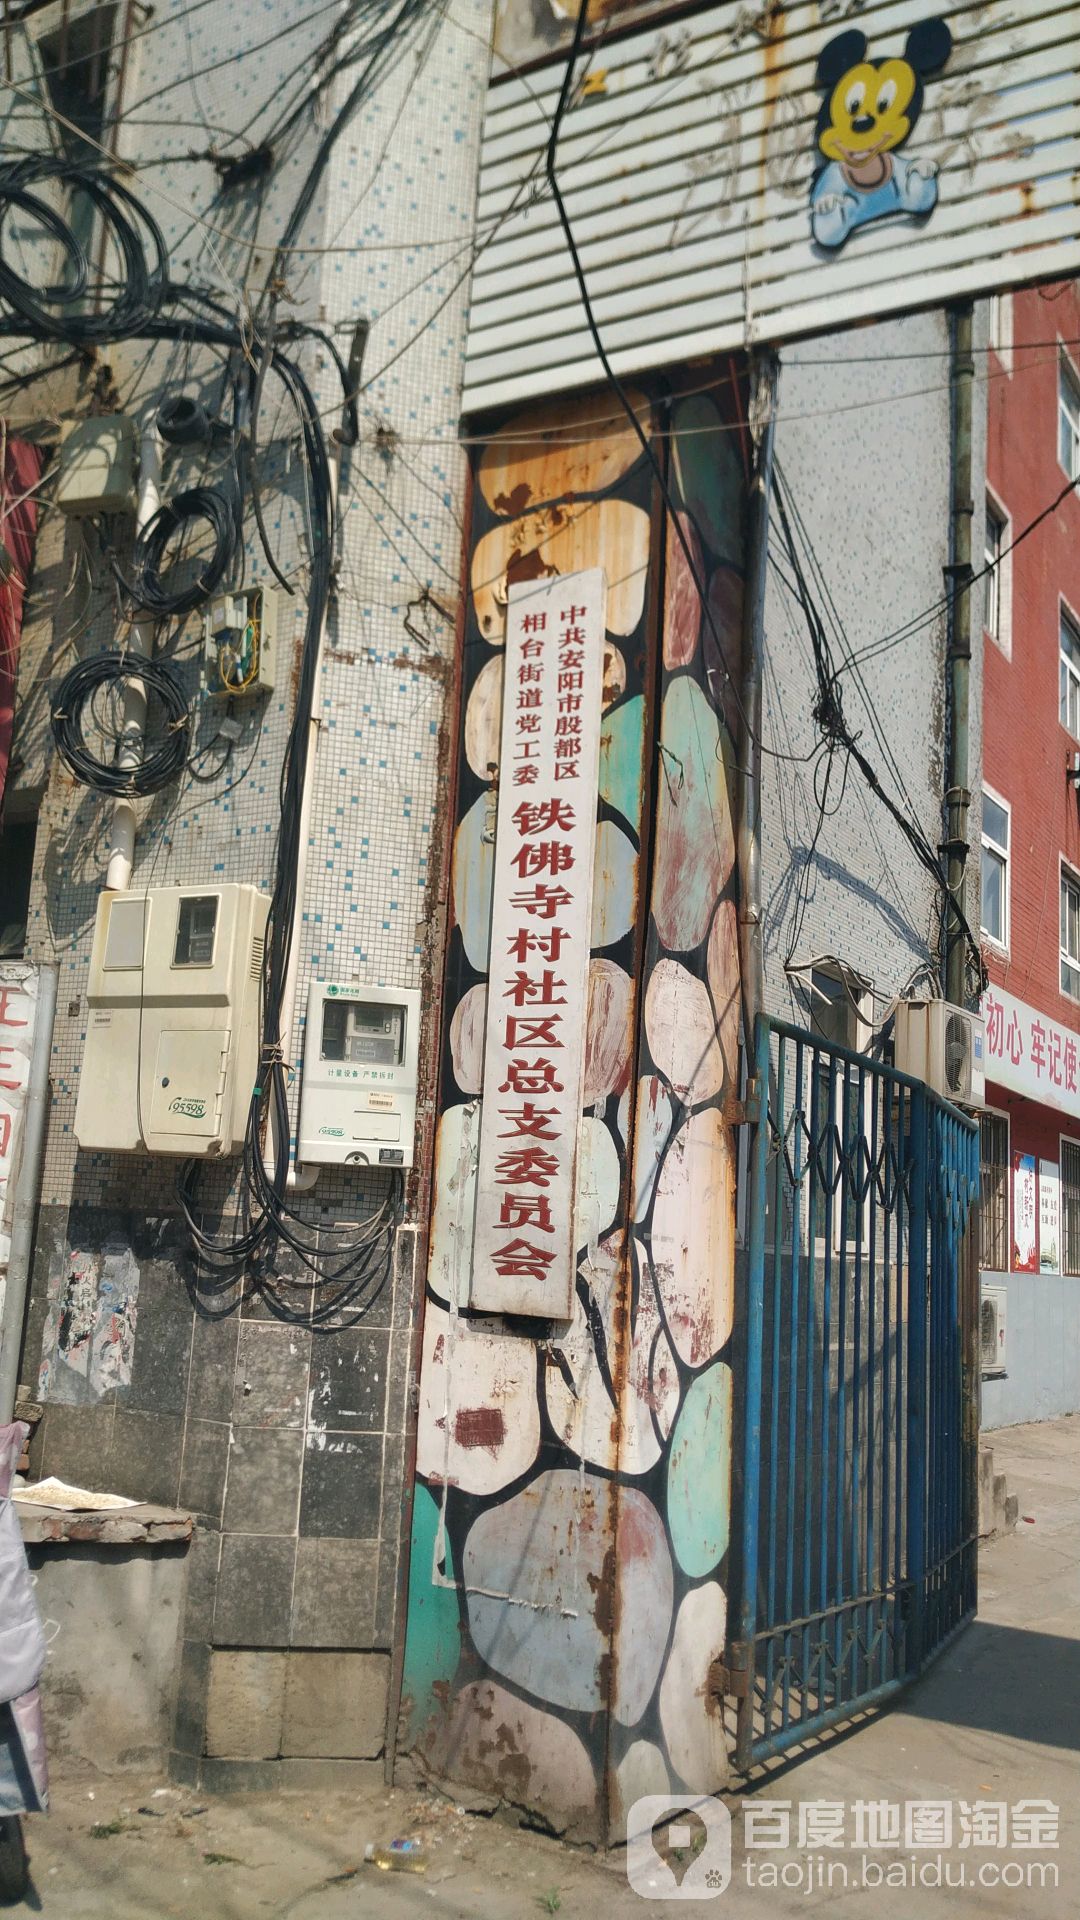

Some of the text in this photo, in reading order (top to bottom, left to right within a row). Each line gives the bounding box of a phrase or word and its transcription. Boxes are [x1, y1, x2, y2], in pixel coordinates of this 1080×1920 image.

[512, 611, 548, 787] 相台街道党工委
[553, 604, 588, 782] 中共安阳市殷都区
[172, 1102, 204, 1115] 95598
[490, 797, 577, 1281] 铁佛寺村社区总支委员会
[978, 993, 1080, 1094] 初心 牢记使
